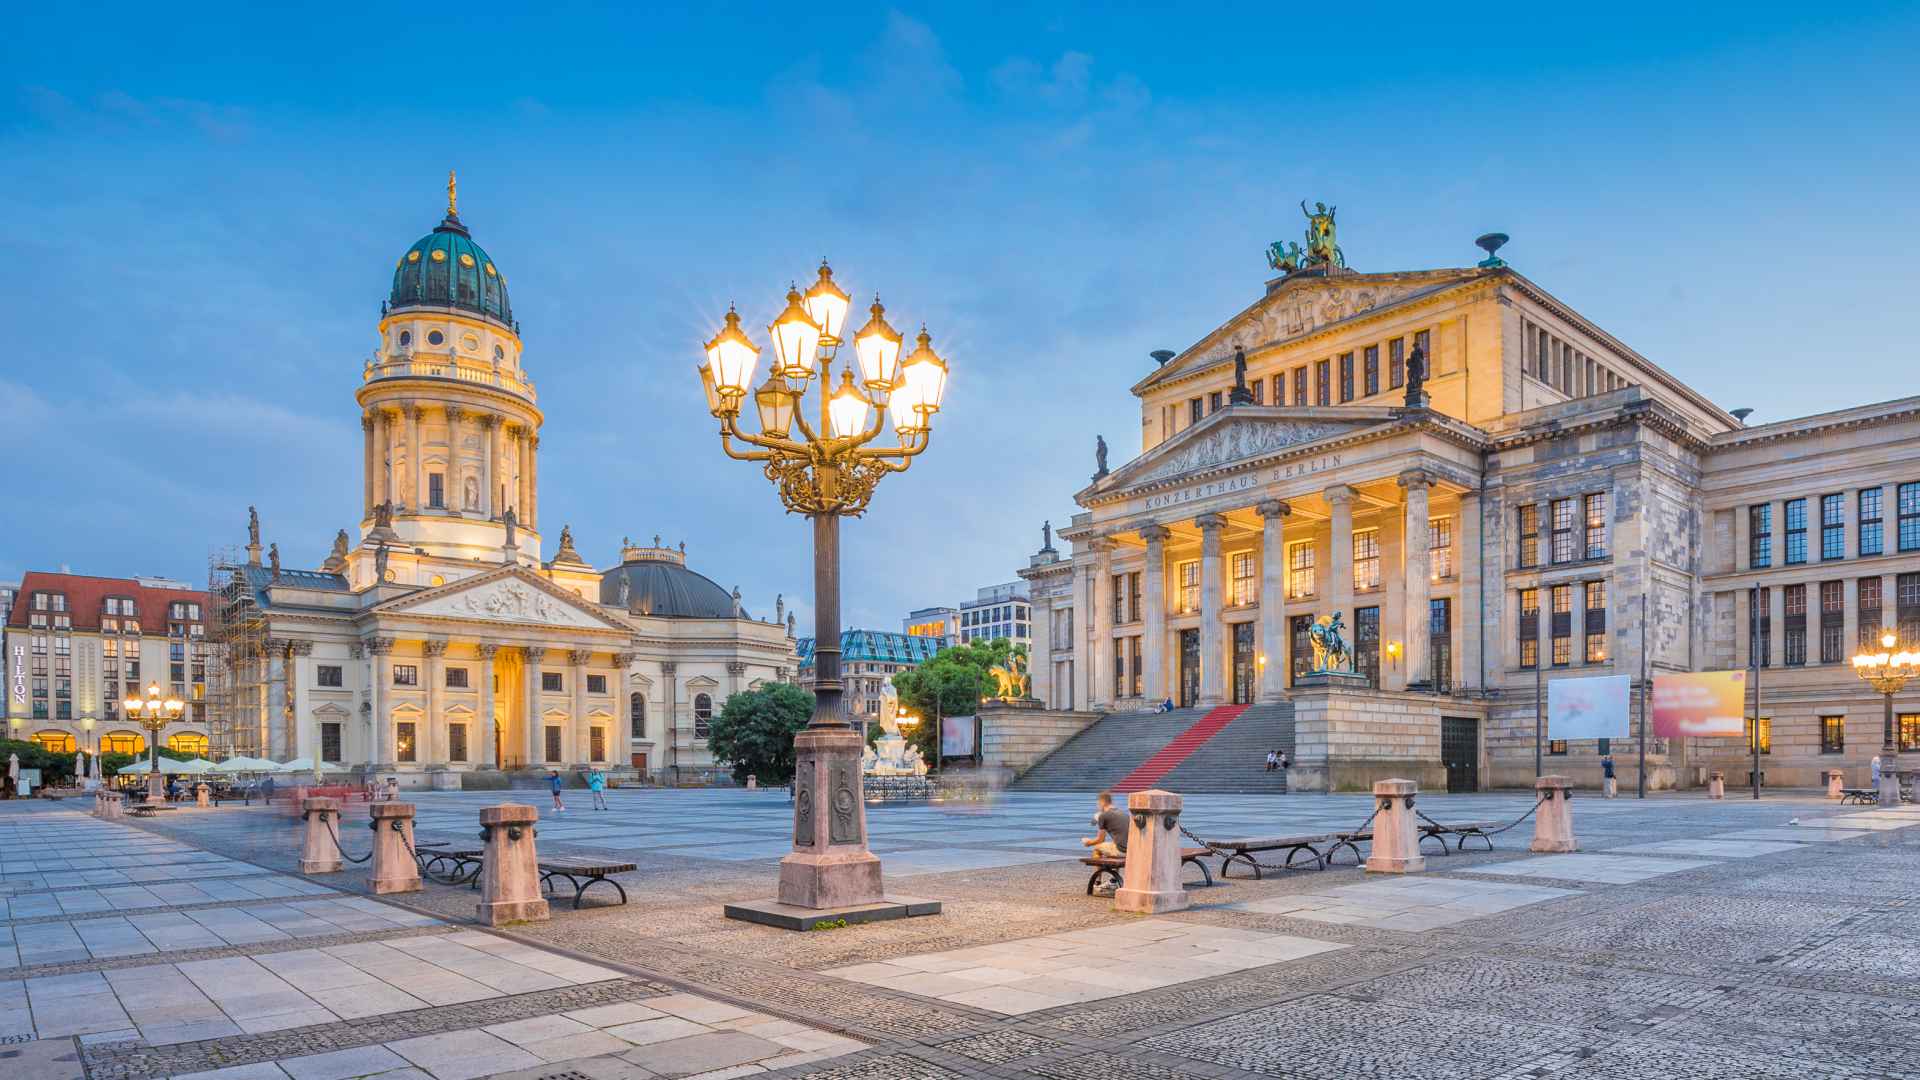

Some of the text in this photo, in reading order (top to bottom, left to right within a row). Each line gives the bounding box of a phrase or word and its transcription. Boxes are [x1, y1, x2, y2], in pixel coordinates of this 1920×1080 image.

[1145, 455, 1342, 509] KONZERTHAUS BERLIN
[14, 646, 25, 704] HILTON
